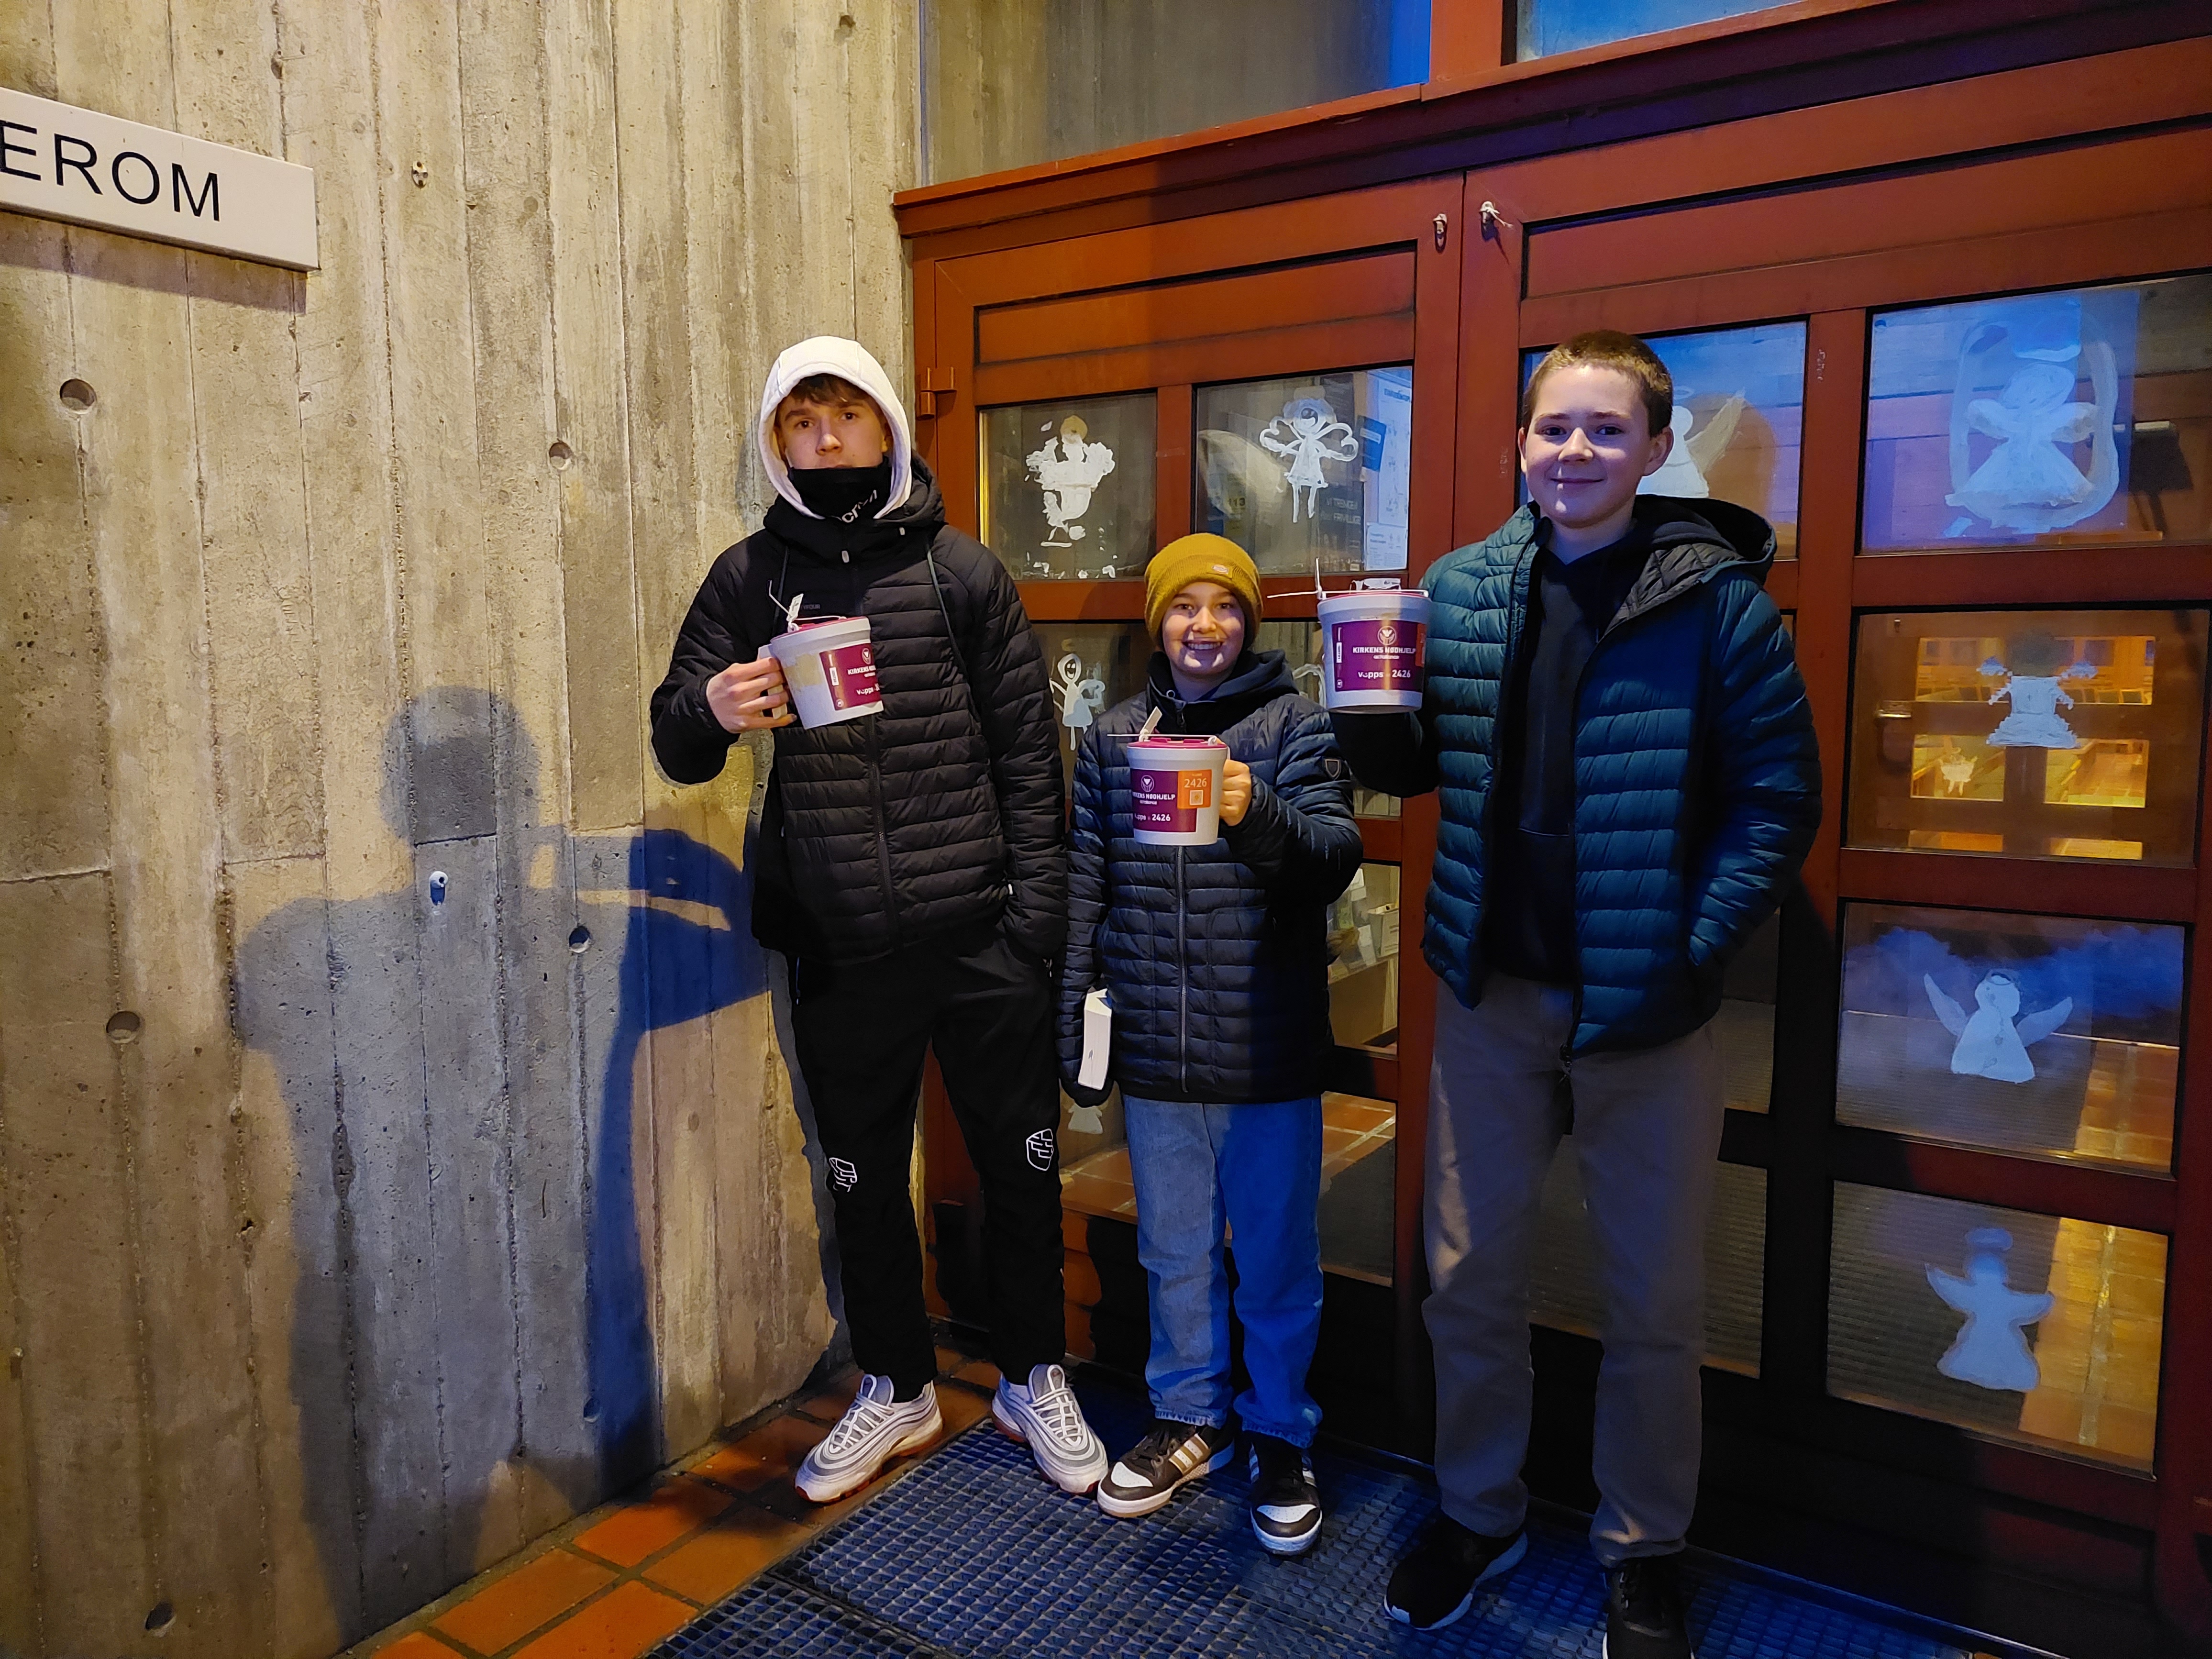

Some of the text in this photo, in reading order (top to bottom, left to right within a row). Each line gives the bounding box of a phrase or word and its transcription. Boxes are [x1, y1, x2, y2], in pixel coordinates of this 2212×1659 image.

[0, 120, 220, 222] EROM
[1392, 669, 1411, 678] 2426
[1184, 778, 1207, 788] 2426
[1152, 813, 1171, 821] 2426
